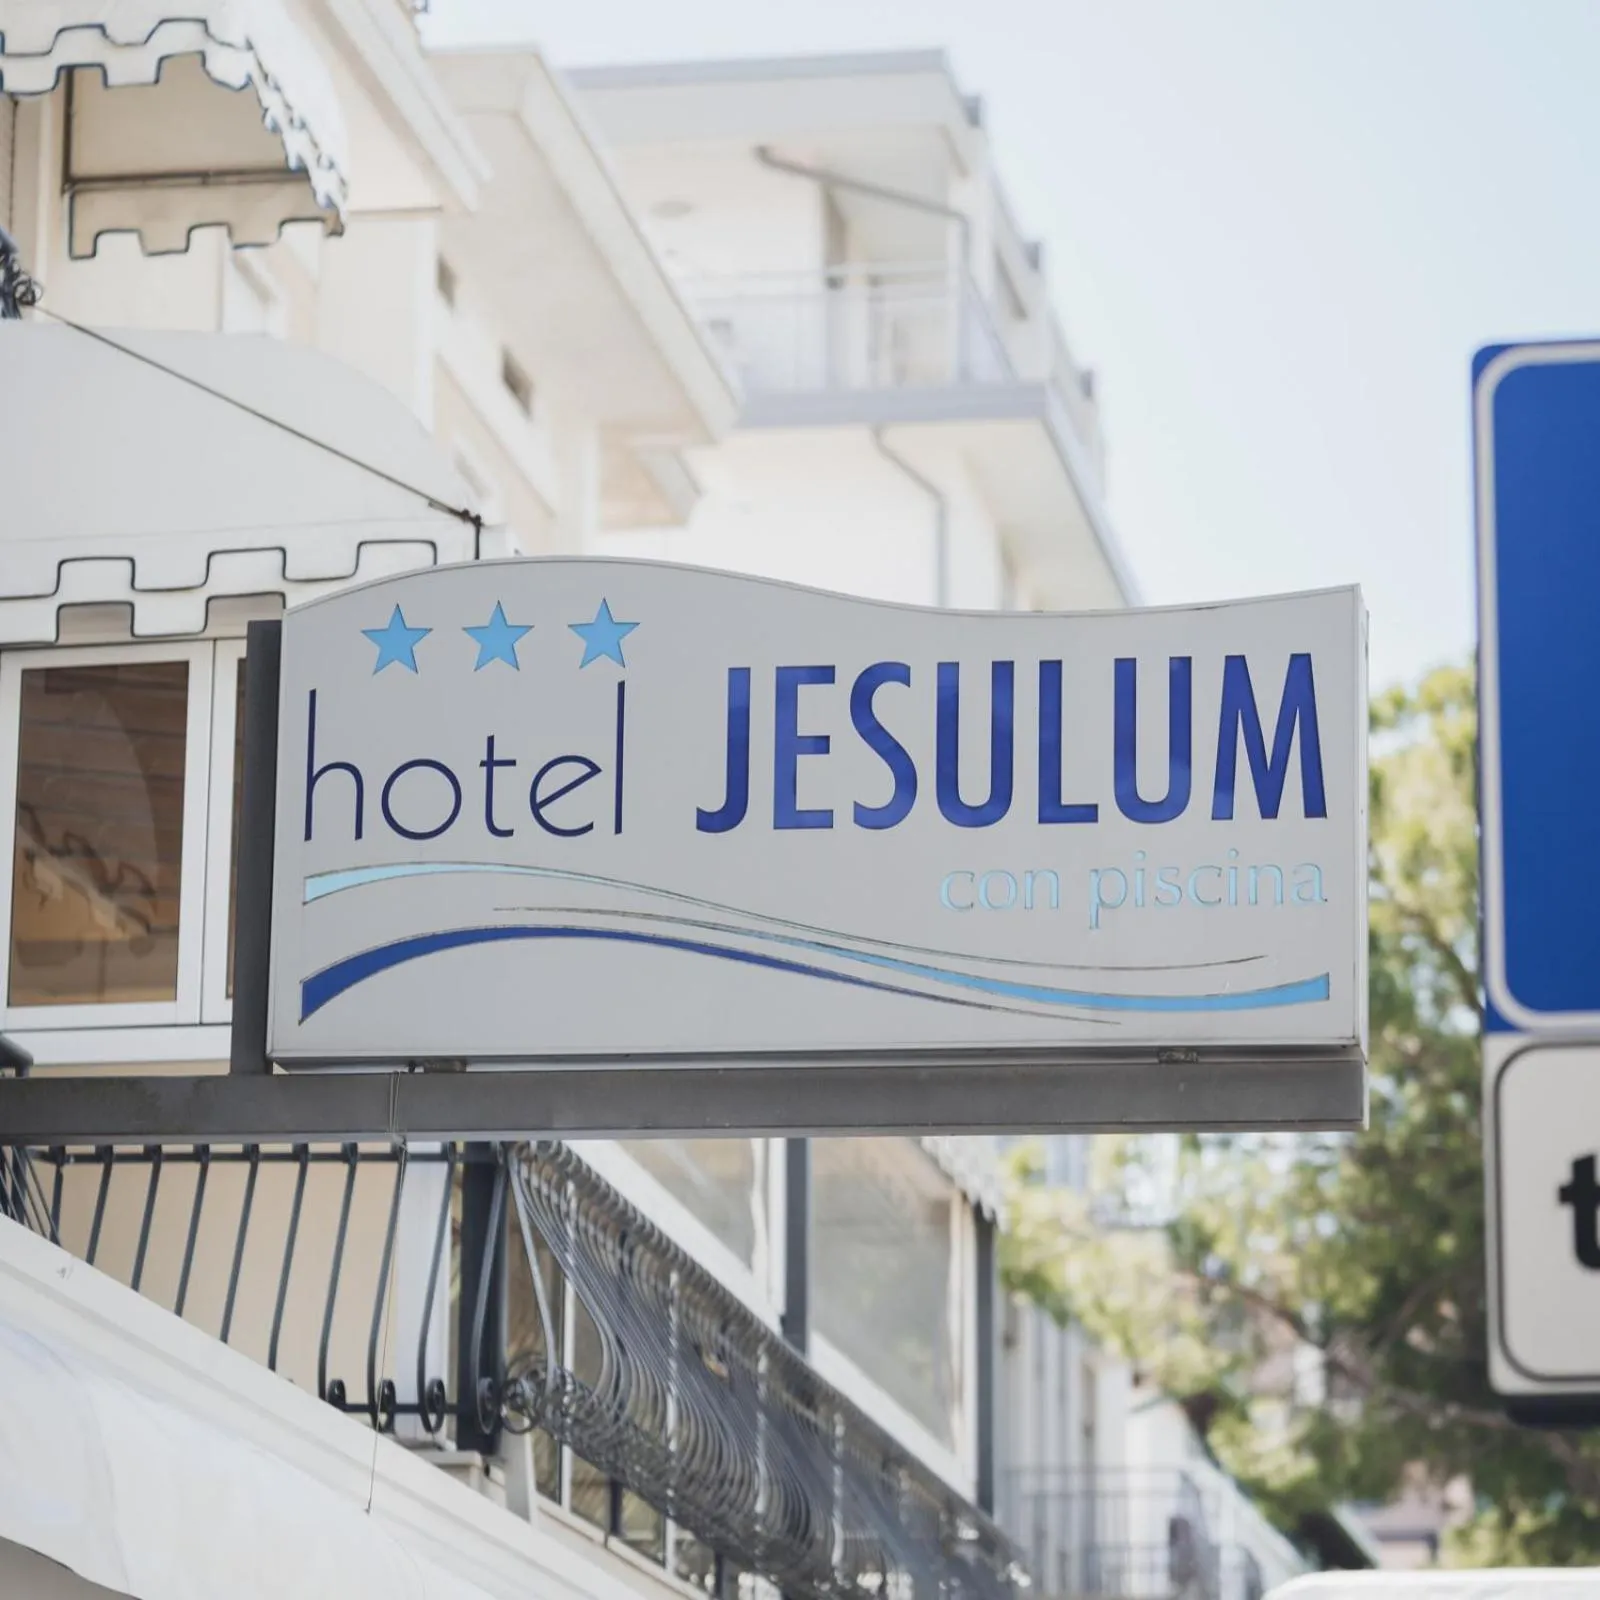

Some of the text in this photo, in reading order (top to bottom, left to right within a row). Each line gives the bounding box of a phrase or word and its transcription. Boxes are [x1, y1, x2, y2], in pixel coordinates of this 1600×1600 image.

[304, 653, 1328, 842] hotel JESULUM
[940, 848, 1328, 931] con piscina
